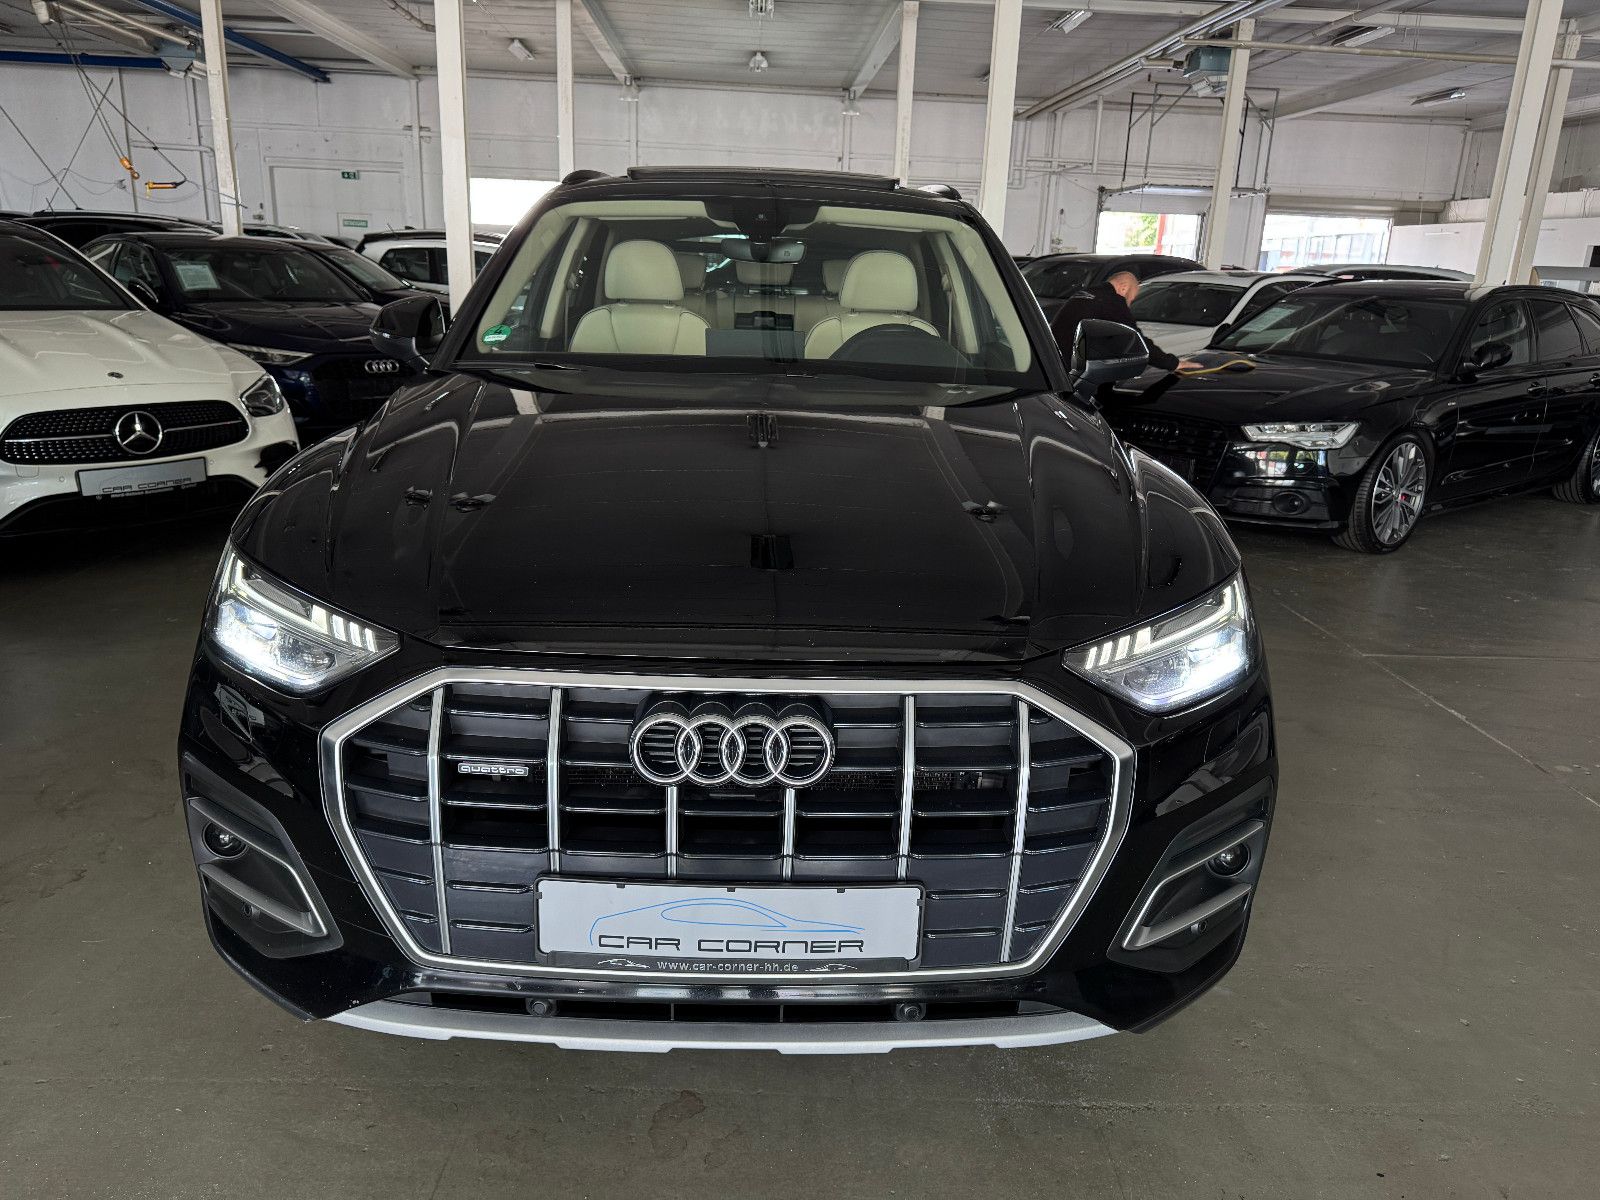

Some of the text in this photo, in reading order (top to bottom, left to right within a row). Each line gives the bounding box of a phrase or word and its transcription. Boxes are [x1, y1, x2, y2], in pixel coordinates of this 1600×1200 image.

[102, 485, 133, 493] CAR
[460, 765, 525, 774] quattro
[598, 934, 865, 954] CAR CORNER
[656, 960, 800, 973] www.car-corner-hh.de
